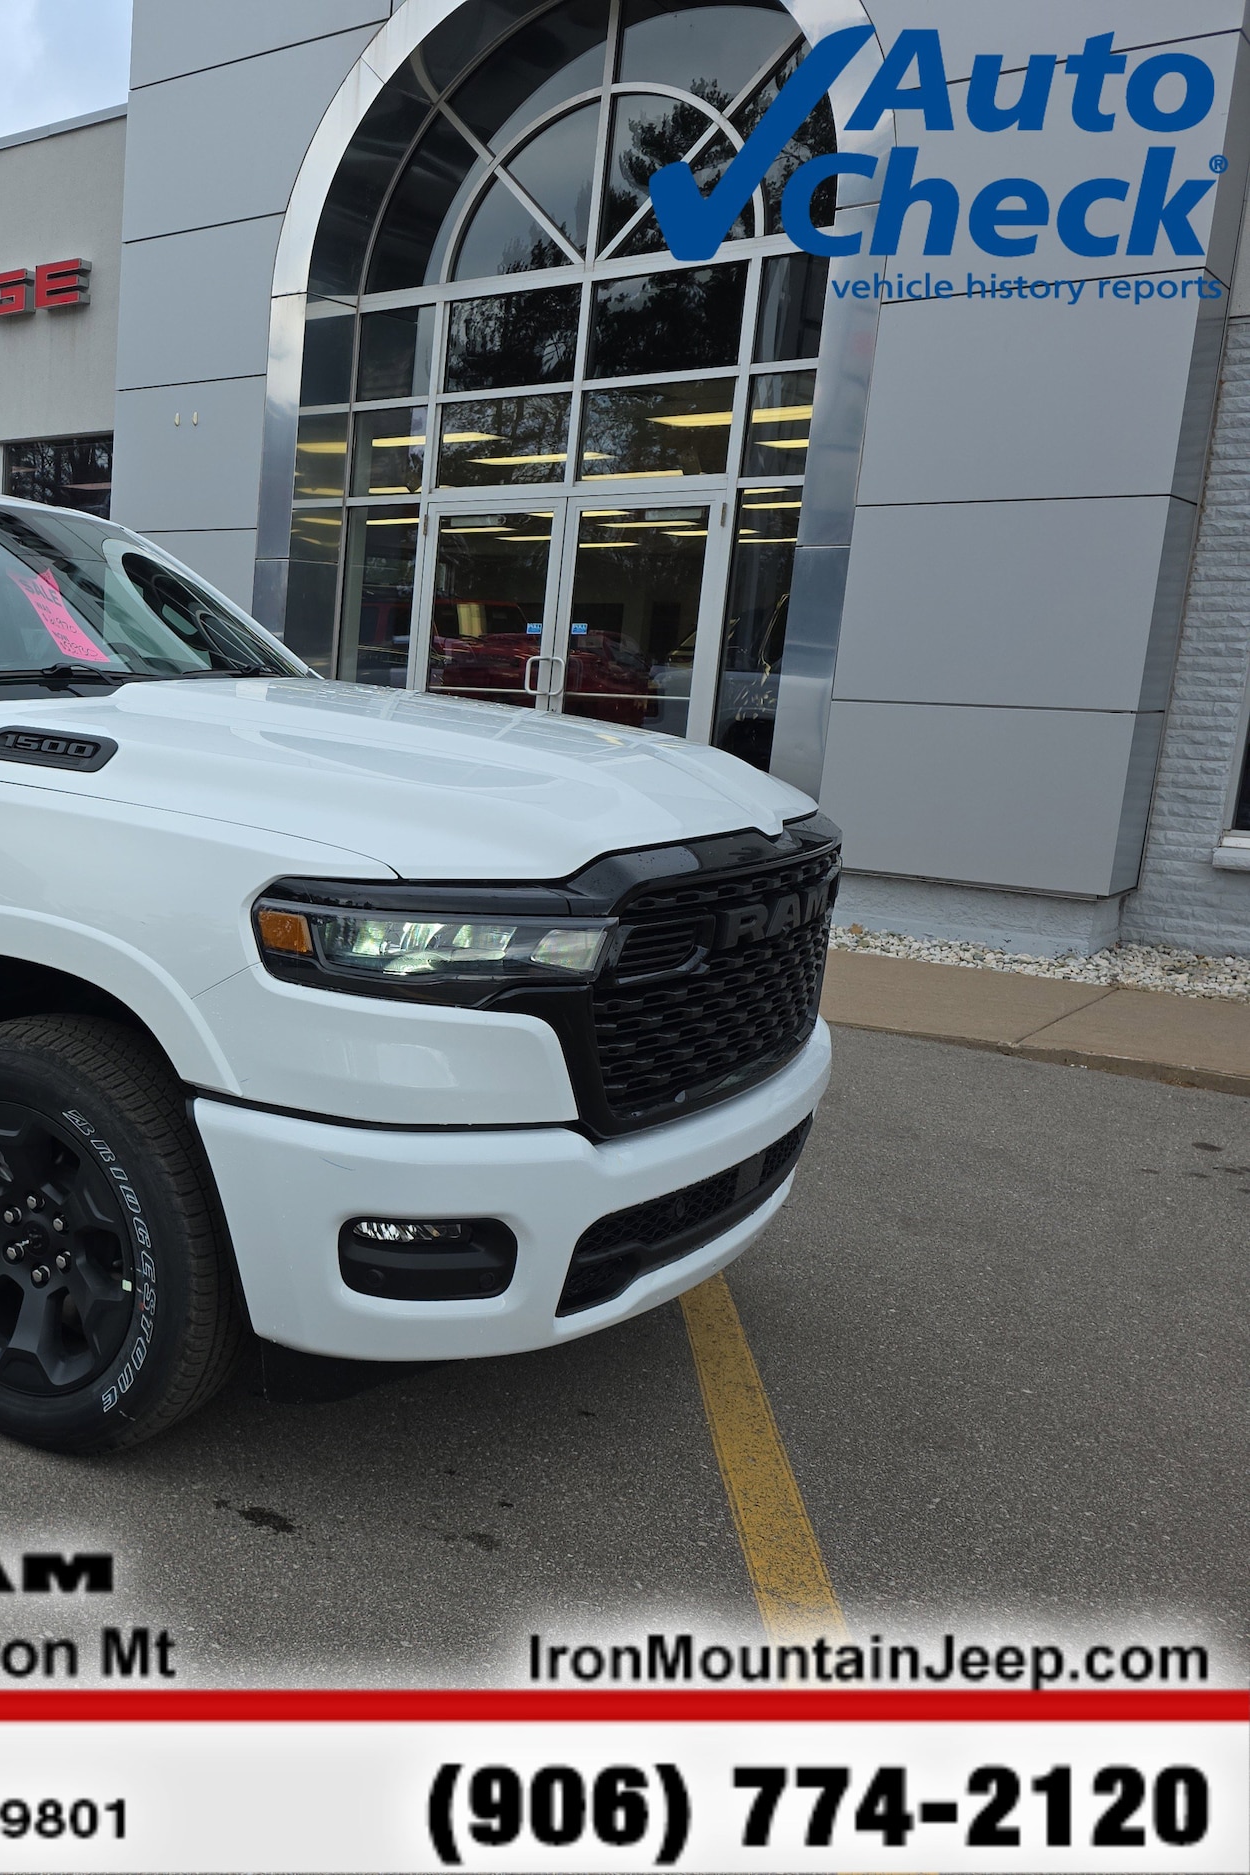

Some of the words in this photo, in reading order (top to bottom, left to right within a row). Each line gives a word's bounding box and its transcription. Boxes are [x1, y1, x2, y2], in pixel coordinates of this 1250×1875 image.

[19, 579, 62, 607] SALE
[4, 732, 97, 758] 1500
[718, 880, 831, 950] RAM
[62, 1108, 157, 1413] BRIDGESTONE
